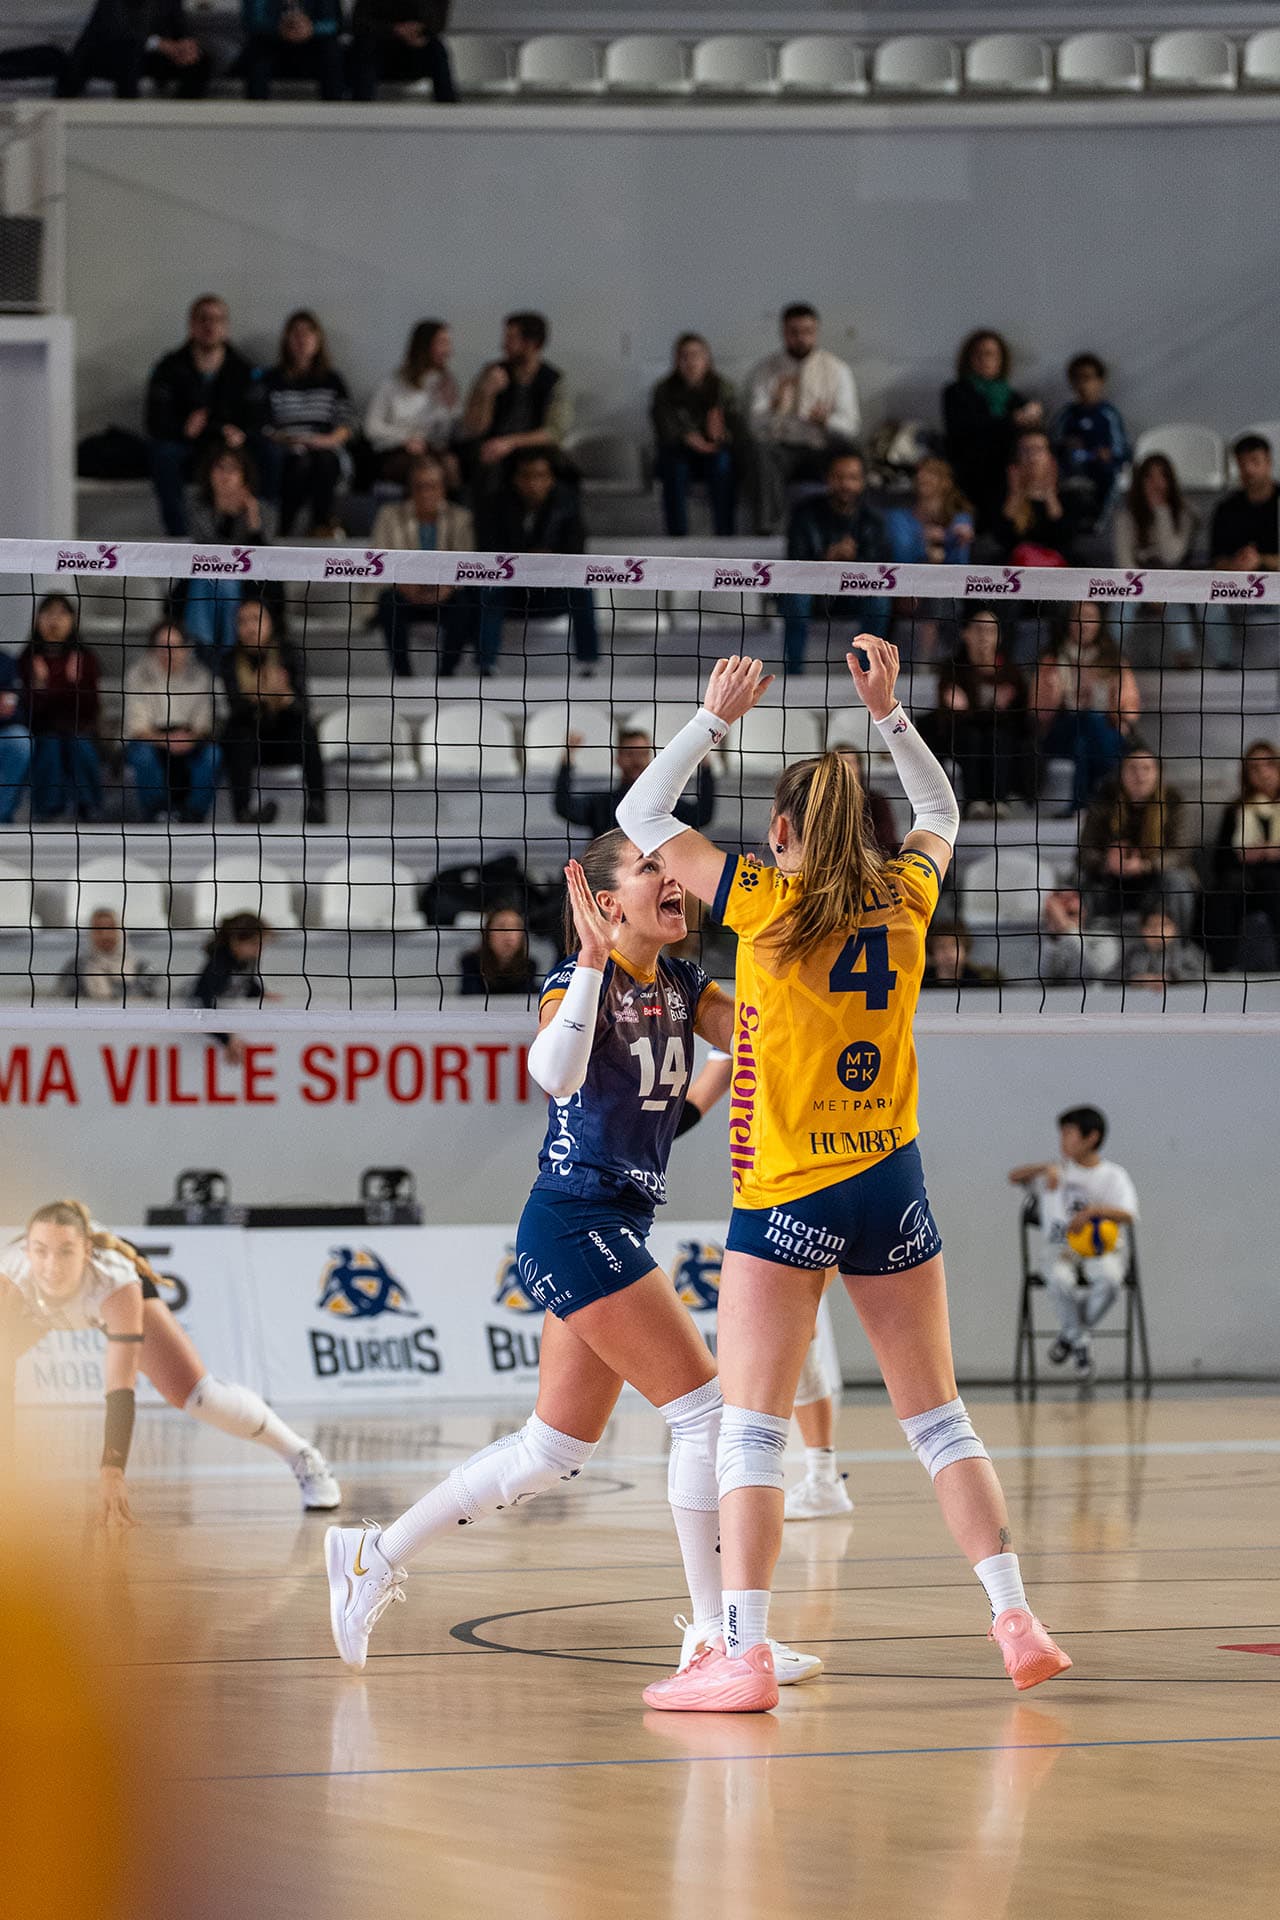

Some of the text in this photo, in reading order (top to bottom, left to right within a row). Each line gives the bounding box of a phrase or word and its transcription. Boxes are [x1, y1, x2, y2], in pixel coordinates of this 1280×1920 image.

[829, 925, 897, 1011] 4
[100, 1045, 276, 1104] VILLE
[301, 1044, 529, 1105] SPORTI
[630, 1037, 688, 1097] 14
[845, 1068, 874, 1082] PK
[846, 1052, 876, 1066] MT
[588, 1230, 617, 1262] CRAFT
[764, 1225, 837, 1265] nation
[728, 1604, 738, 1636] CRAFT
